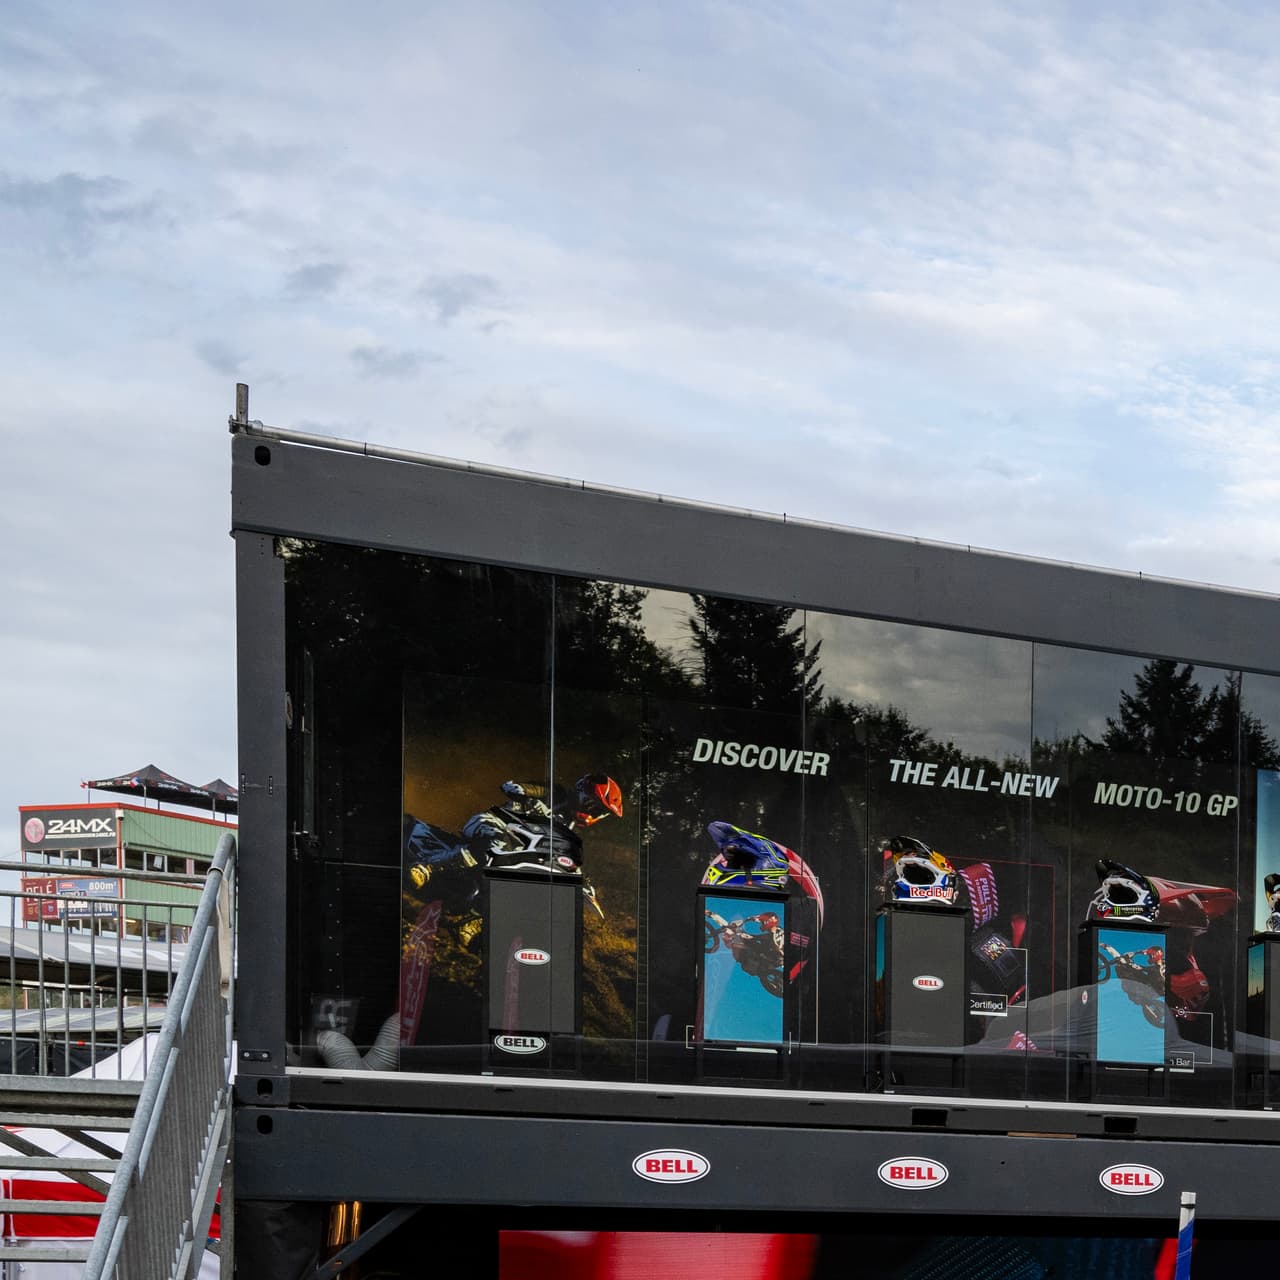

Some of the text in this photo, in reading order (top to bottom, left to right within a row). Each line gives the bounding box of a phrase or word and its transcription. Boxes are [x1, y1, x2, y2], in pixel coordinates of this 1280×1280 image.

[692, 738, 831, 776] DISCOVER
[889, 759, 1059, 798] THE ALL-NEW
[1093, 782, 1239, 817] MOTO-10 GP
[48, 818, 113, 834] 24MX
[911, 886, 934, 898] Red
[520, 952, 545, 960] BELL
[917, 979, 939, 987] BELL
[503, 1037, 539, 1048] BELL
[645, 1160, 698, 1175] BELL
[890, 1166, 938, 1182] BELL
[1110, 1172, 1154, 1187] BELL
